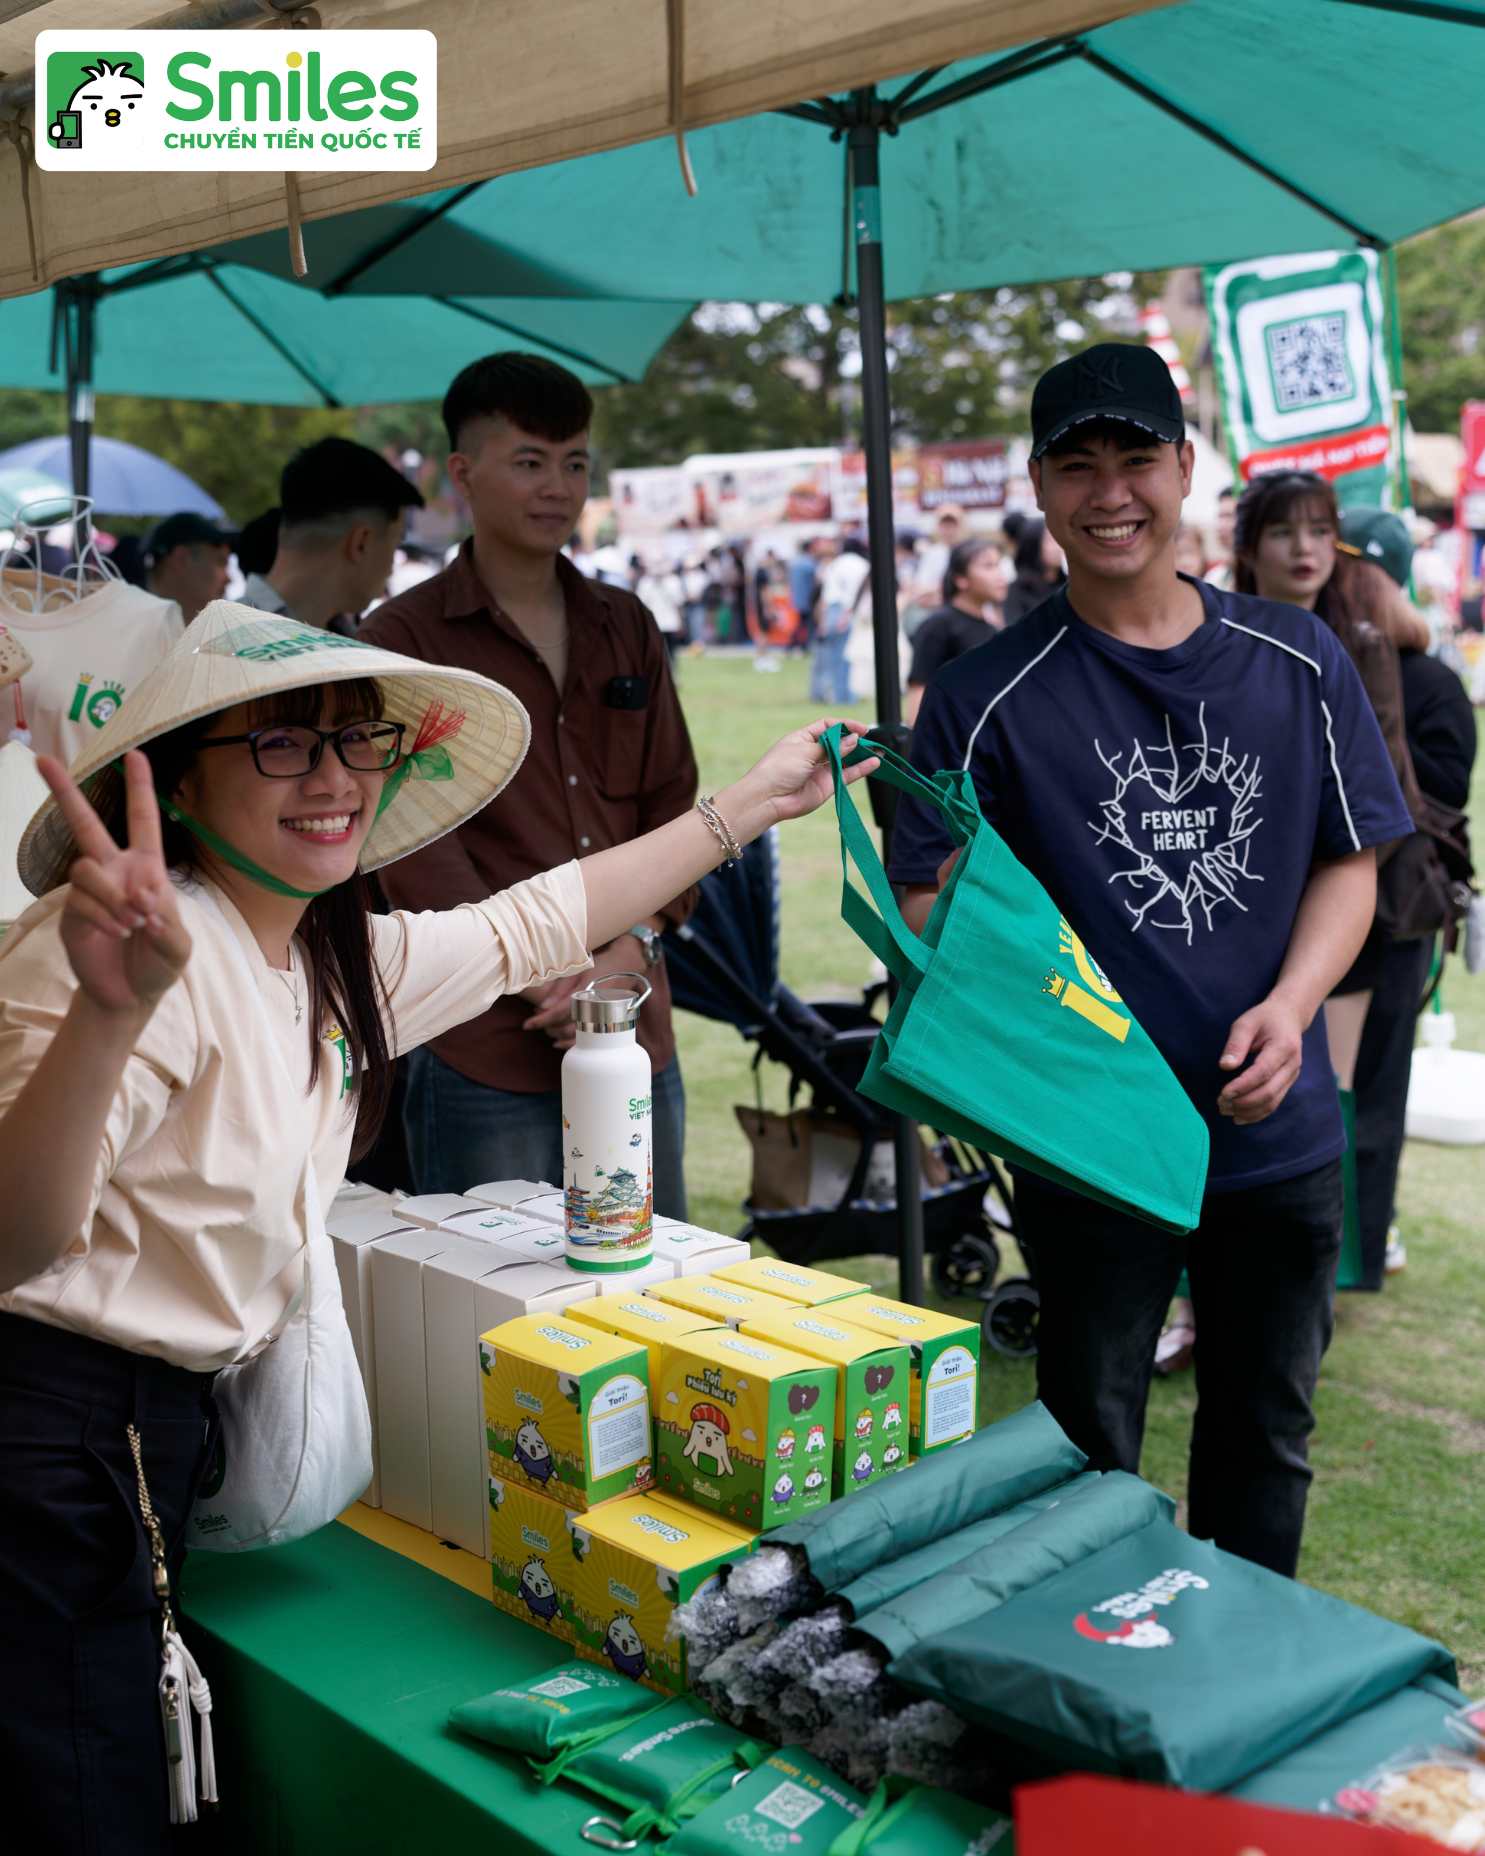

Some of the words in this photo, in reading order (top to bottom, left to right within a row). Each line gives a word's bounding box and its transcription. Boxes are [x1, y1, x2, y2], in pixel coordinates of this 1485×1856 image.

[1141, 806, 1218, 830] FERVENT
[1153, 829, 1208, 851] HEART
[633, 1504, 690, 1543] Smiles
